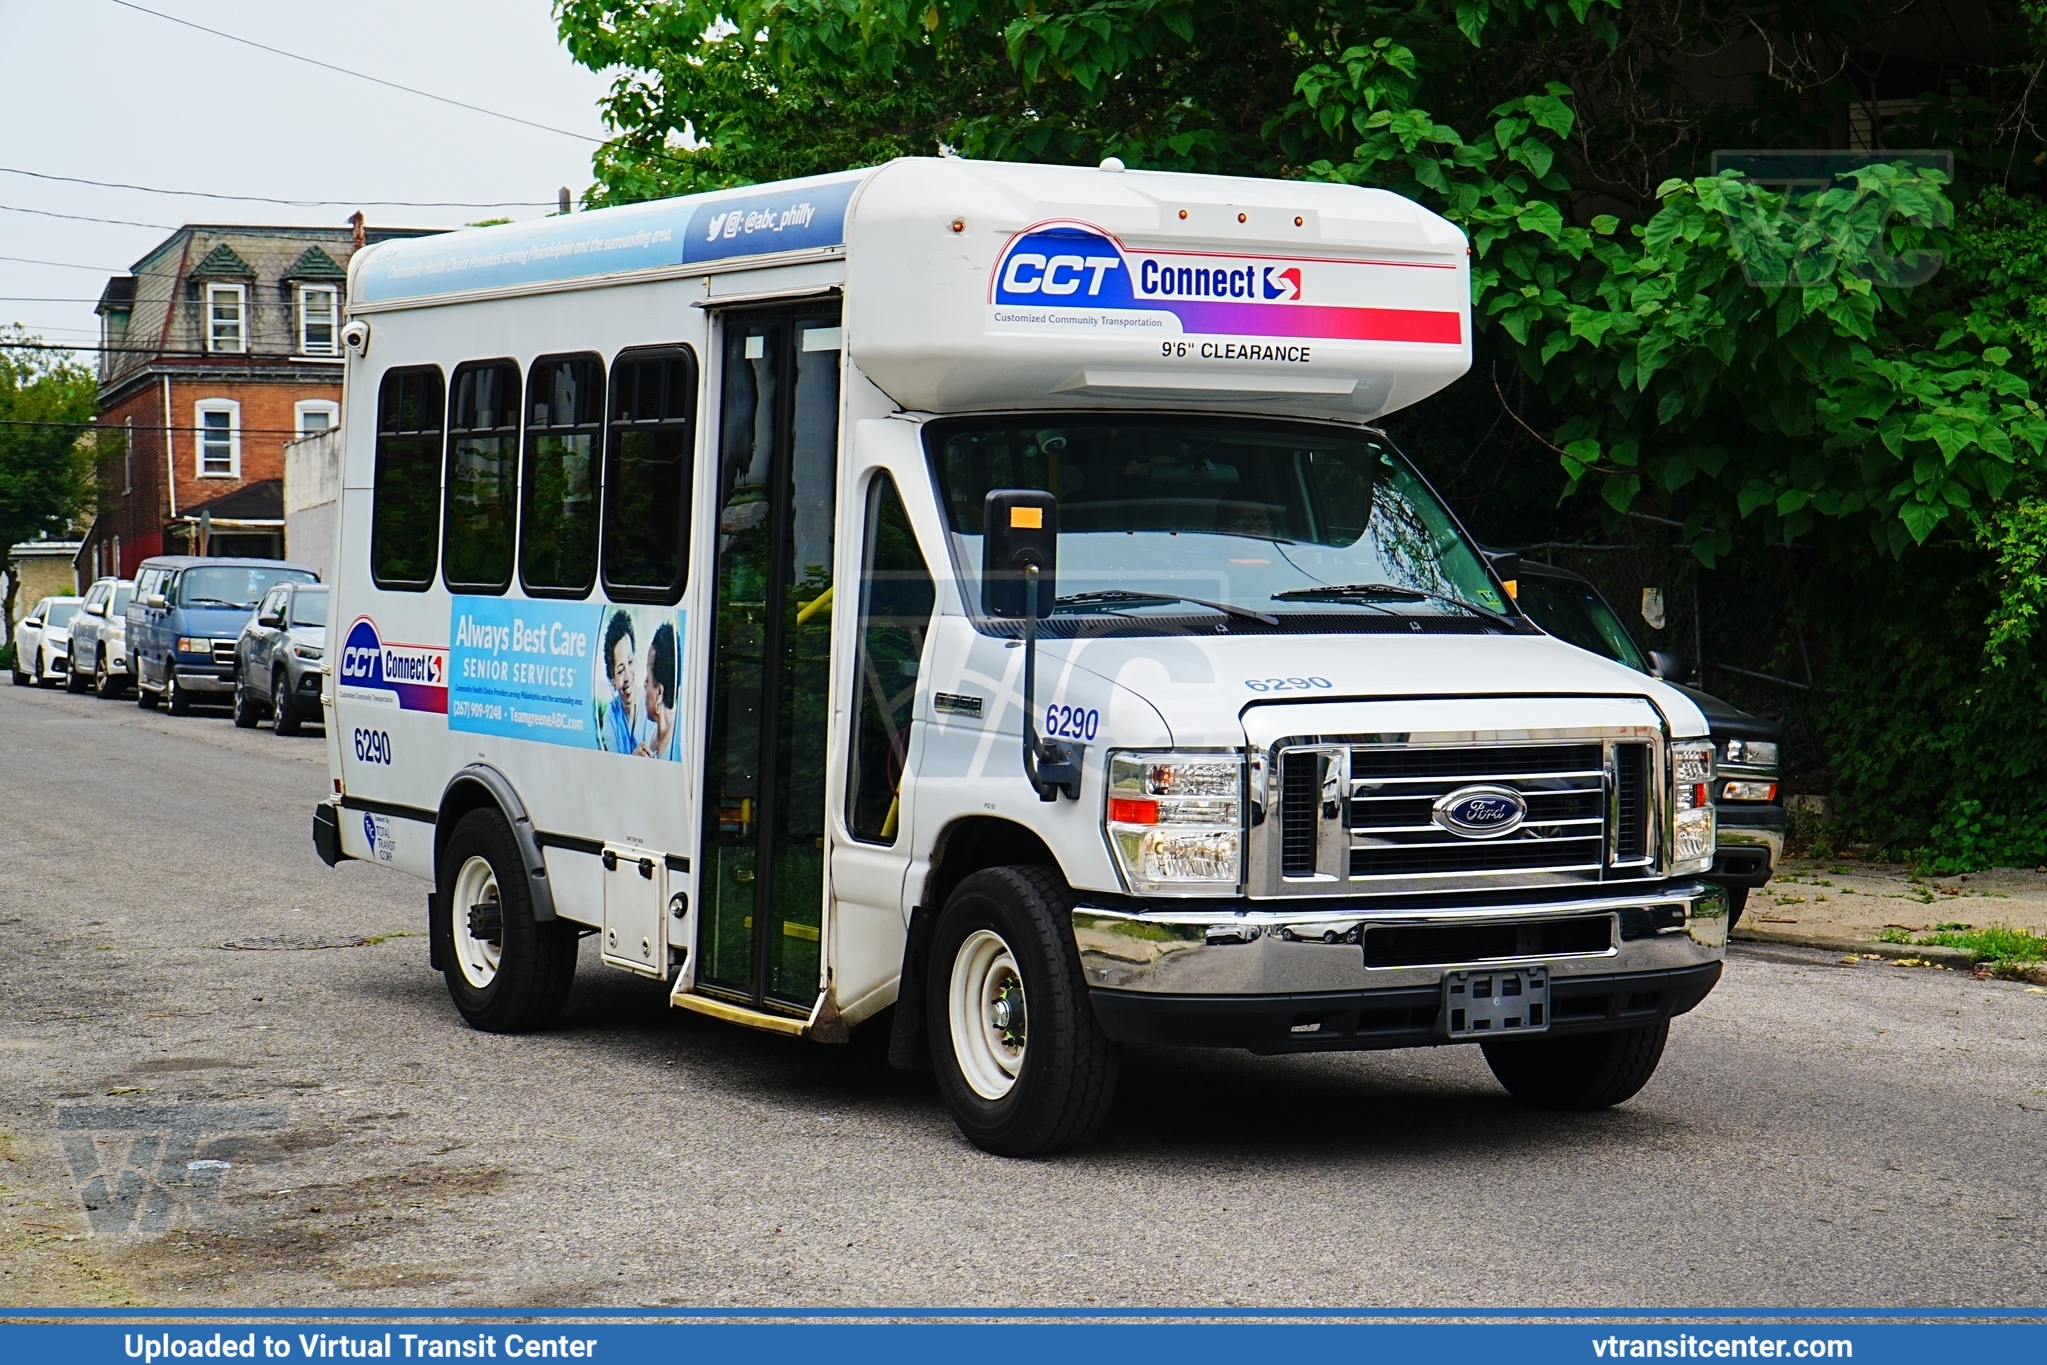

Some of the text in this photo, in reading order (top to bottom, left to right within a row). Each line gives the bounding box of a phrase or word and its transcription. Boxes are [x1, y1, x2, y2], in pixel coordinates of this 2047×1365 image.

[745, 203, 815, 234] @abc_philly
[447, 254, 470, 272] Choice
[470, 251, 501, 269] Providers
[501, 247, 527, 265] serving
[528, 238, 574, 260] Philadelphia
[574, 236, 591, 254] and
[590, 234, 603, 251] the
[603, 230, 652, 251] surrounding
[1002, 253, 1255, 299] CCT Connect
[994, 312, 1162, 328] Customized Community Transportation
[1162, 341, 1310, 363] 9'6" CLEARANCE
[455, 614, 587, 657] Always Best Care
[342, 646, 425, 681] CCT Connect
[463, 657, 508, 681] SENIOR
[1244, 676, 1333, 692] 6290
[453, 700, 584, 730] (267) 909-9248 TeamgreeneABC.com
[1046, 704, 1099, 741] 6290
[354, 727, 392, 766] 6290
[1467, 800, 1505, 820] Ford
